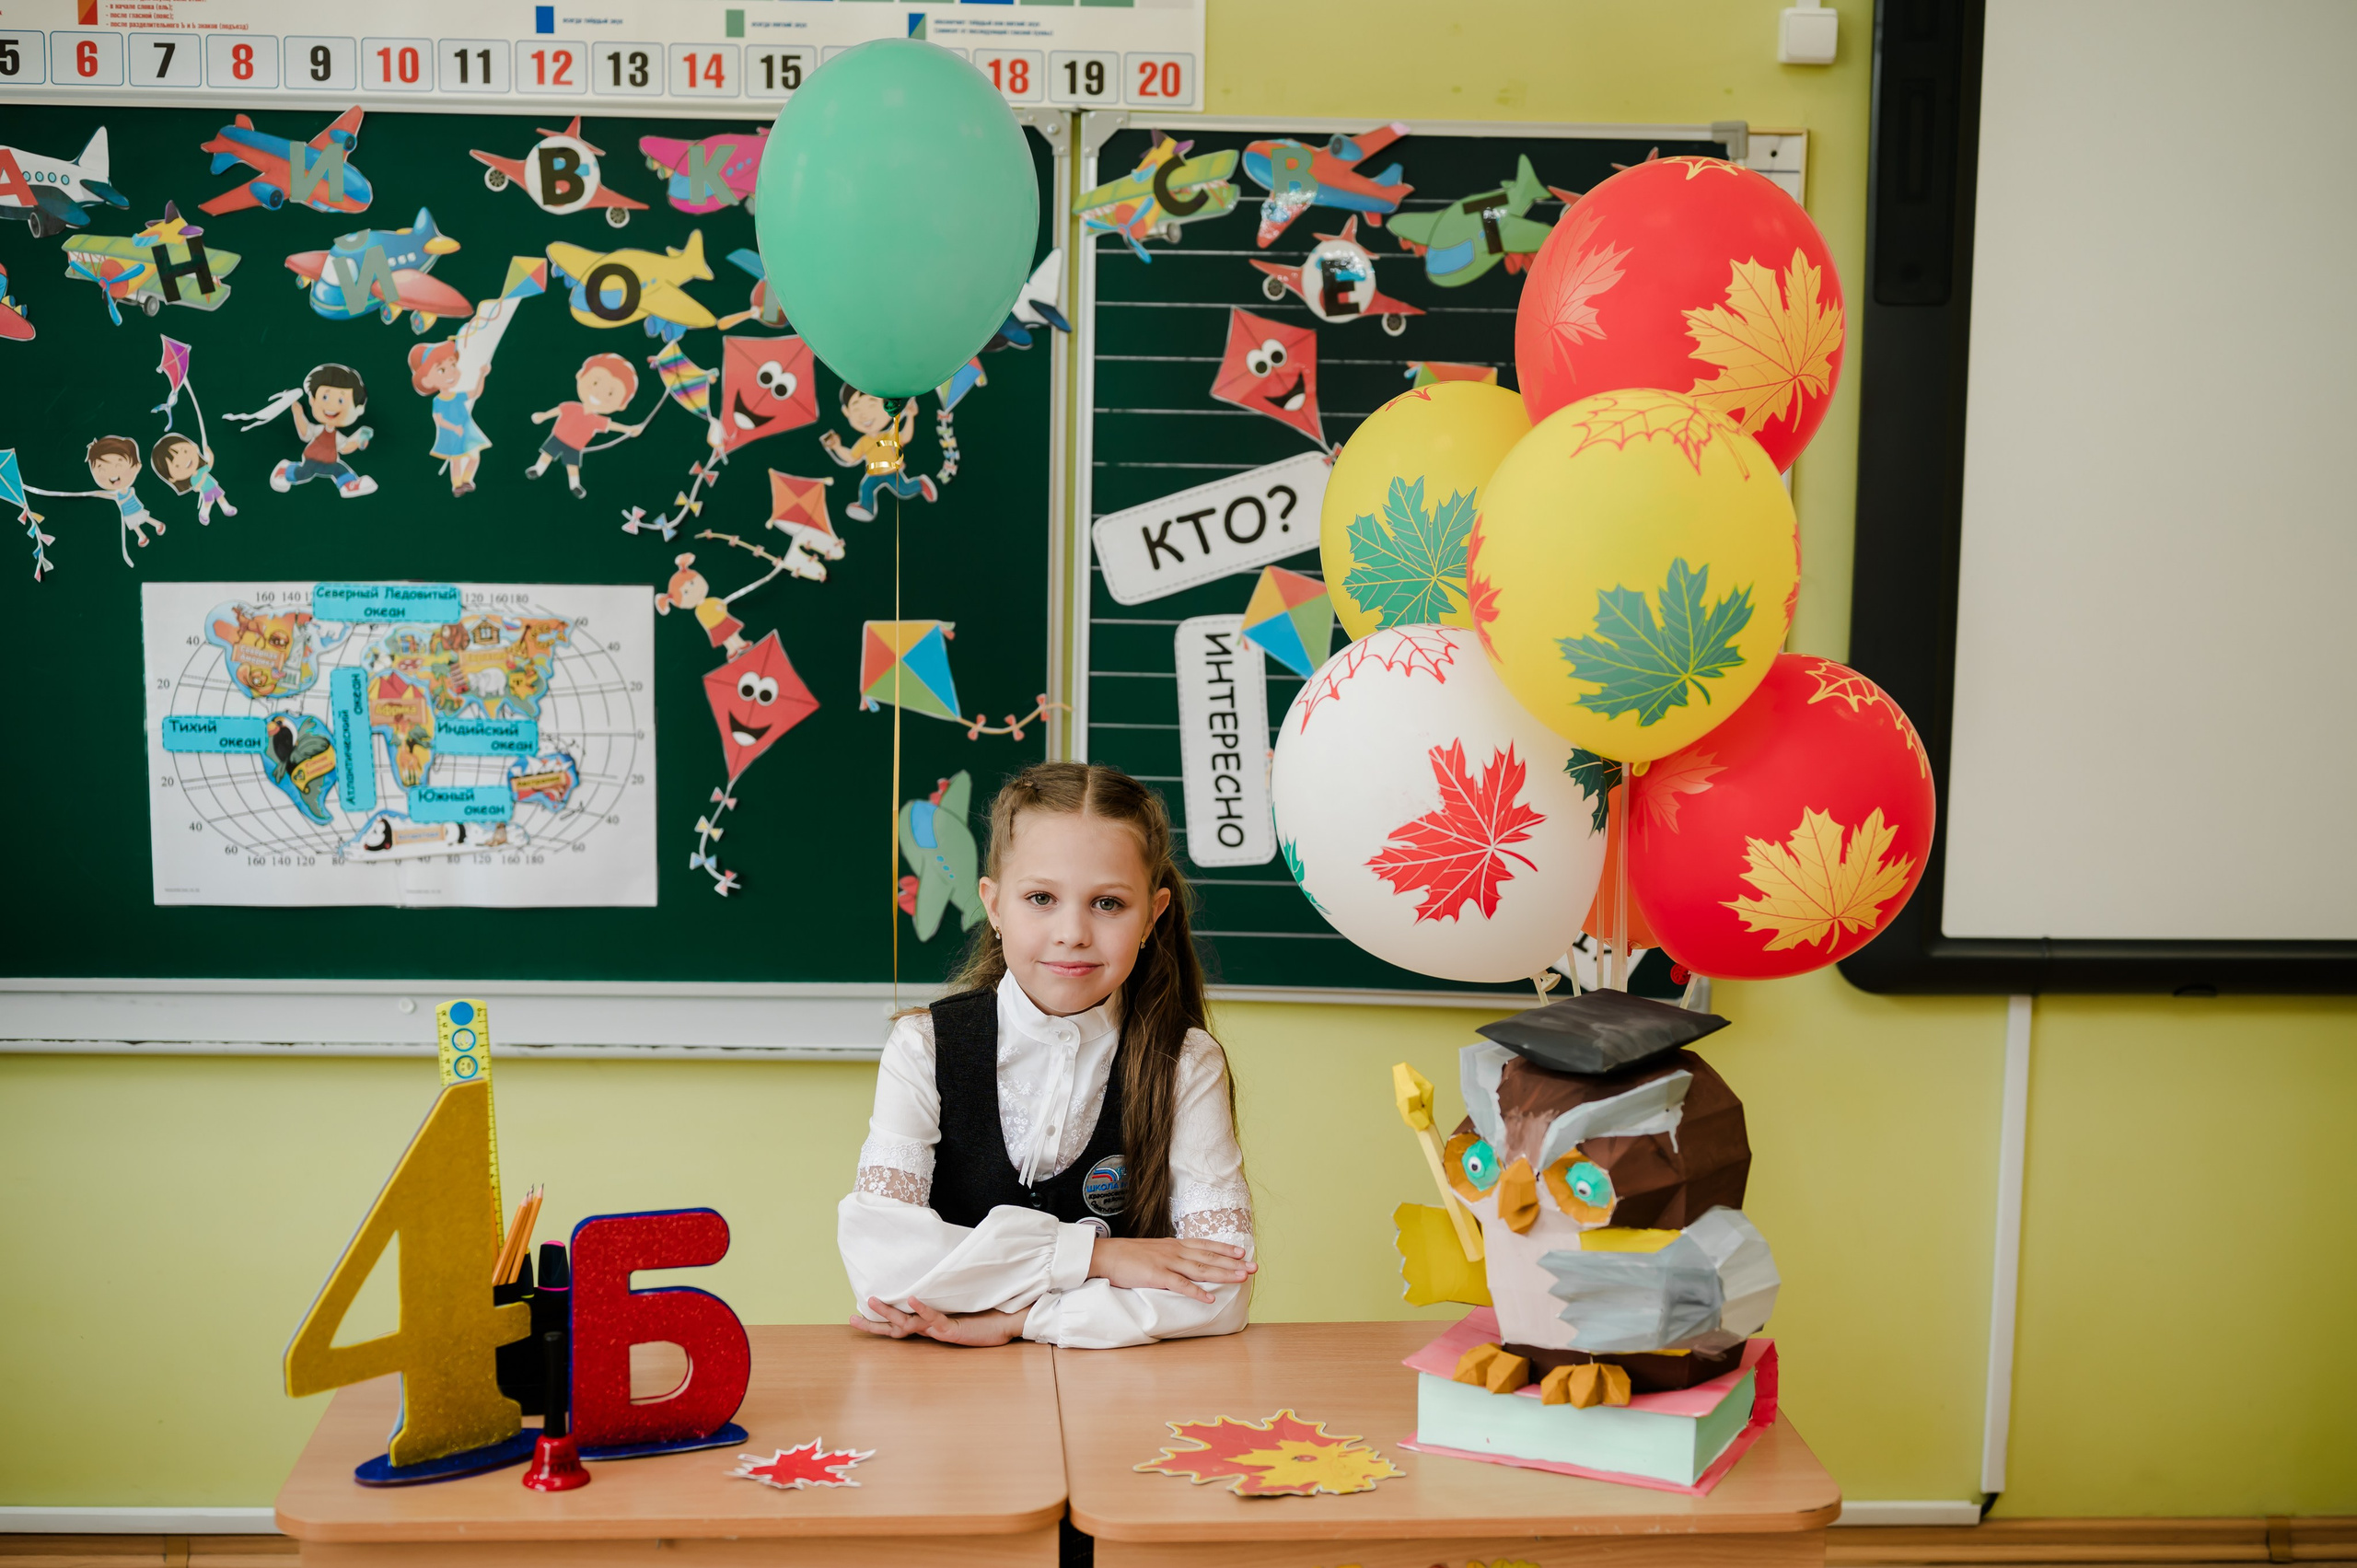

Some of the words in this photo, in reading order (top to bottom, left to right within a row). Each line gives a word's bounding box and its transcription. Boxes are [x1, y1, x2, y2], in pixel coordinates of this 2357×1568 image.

[0, 40, 19, 76] 5
[76, 41, 99, 77] 6
[154, 42, 176, 78] 7
[231, 43, 254, 80] 8
[309, 45, 332, 81] 9
[377, 47, 419, 84] 10
[454, 49, 492, 85] 11
[530, 50, 573, 87] 12
[607, 51, 648, 88] 13
[683, 52, 725, 89] 14
[761, 54, 801, 90] 15
[988, 58, 1028, 94] 18
[1063, 59, 1104, 96] 19
[1138, 61, 1179, 98] 20
[290, 141, 343, 203] И
[539, 146, 585, 205] В
[689, 145, 738, 205] К
[1271, 147, 1318, 204] В
[1154, 157, 1210, 216] С
[1462, 193, 1509, 255] Т
[151, 236, 216, 303] Н
[585, 262, 642, 321] О
[1320, 257, 1363, 317] Е
[1141, 485, 1297, 570] КТО?
[256, 591, 275, 601] 160
[283, 591, 301, 601] 140
[316, 586, 378, 601] Северный
[385, 587, 457, 601] Ледовитый
[465, 593, 483, 603] 120
[491, 593, 508, 603] 160
[510, 594, 529, 604] 180
[364, 607, 405, 618] океан
[575, 617, 588, 627] 60
[186, 636, 200, 646] 40
[607, 641, 621, 652] 40
[157, 679, 170, 690] 20
[630, 680, 643, 691] 20
[351, 673, 363, 715] океан
[168, 719, 216, 734] Тихий
[437, 721, 519, 737] Индийский
[219, 738, 261, 748] океан
[491, 739, 533, 751] океан
[1204, 633, 1244, 848] ИНТЕРЕСНО
[339, 709, 355, 806] Атлантический
[160, 776, 174, 787] 20
[631, 774, 644, 784] 20
[418, 788, 475, 802] Южный
[464, 805, 505, 816] океан
[189, 821, 203, 831] 40
[606, 815, 620, 825] 40
[225, 845, 238, 855] 60
[572, 842, 586, 853] 60
[247, 856, 266, 866] 160
[272, 856, 291, 866] 140
[296, 856, 315, 866] 120
[331, 856, 345, 866] 80
[447, 854, 460, 865] 80
[473, 854, 492, 865] 120
[502, 854, 520, 865] 160
[526, 854, 544, 865] 180
[1086, 1182, 1120, 1192] ШКОЛА
[283, 1078, 532, 1469] 4
[570, 1207, 751, 1449] Б
